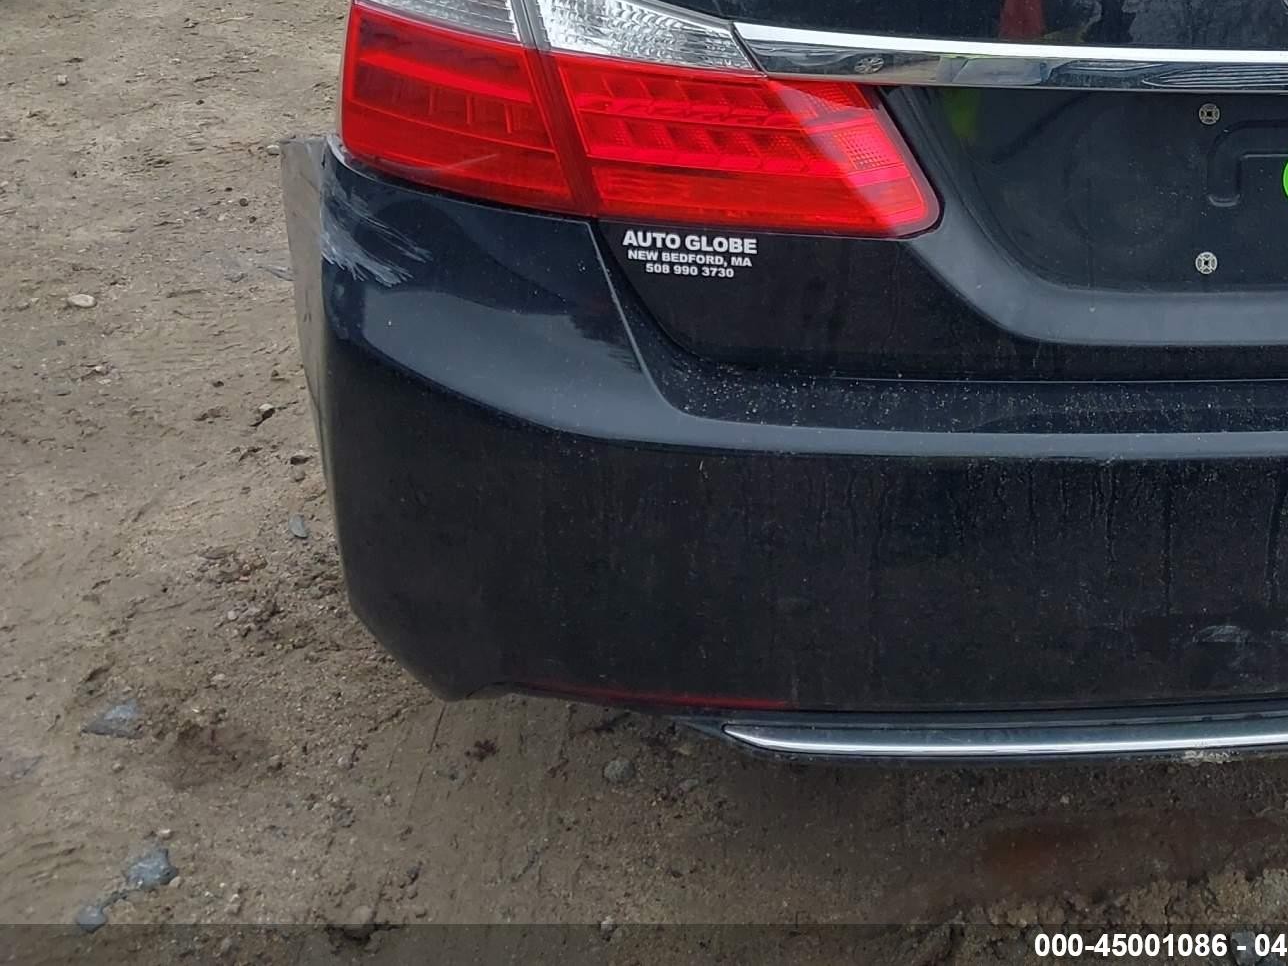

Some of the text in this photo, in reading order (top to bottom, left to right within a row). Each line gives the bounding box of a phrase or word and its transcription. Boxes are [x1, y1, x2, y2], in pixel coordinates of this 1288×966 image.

[622, 230, 758, 254] AUTO GLOBE
[627, 249, 753, 267] NEW BEDFORD, MA
[645, 263, 735, 278] 508 990 3730
